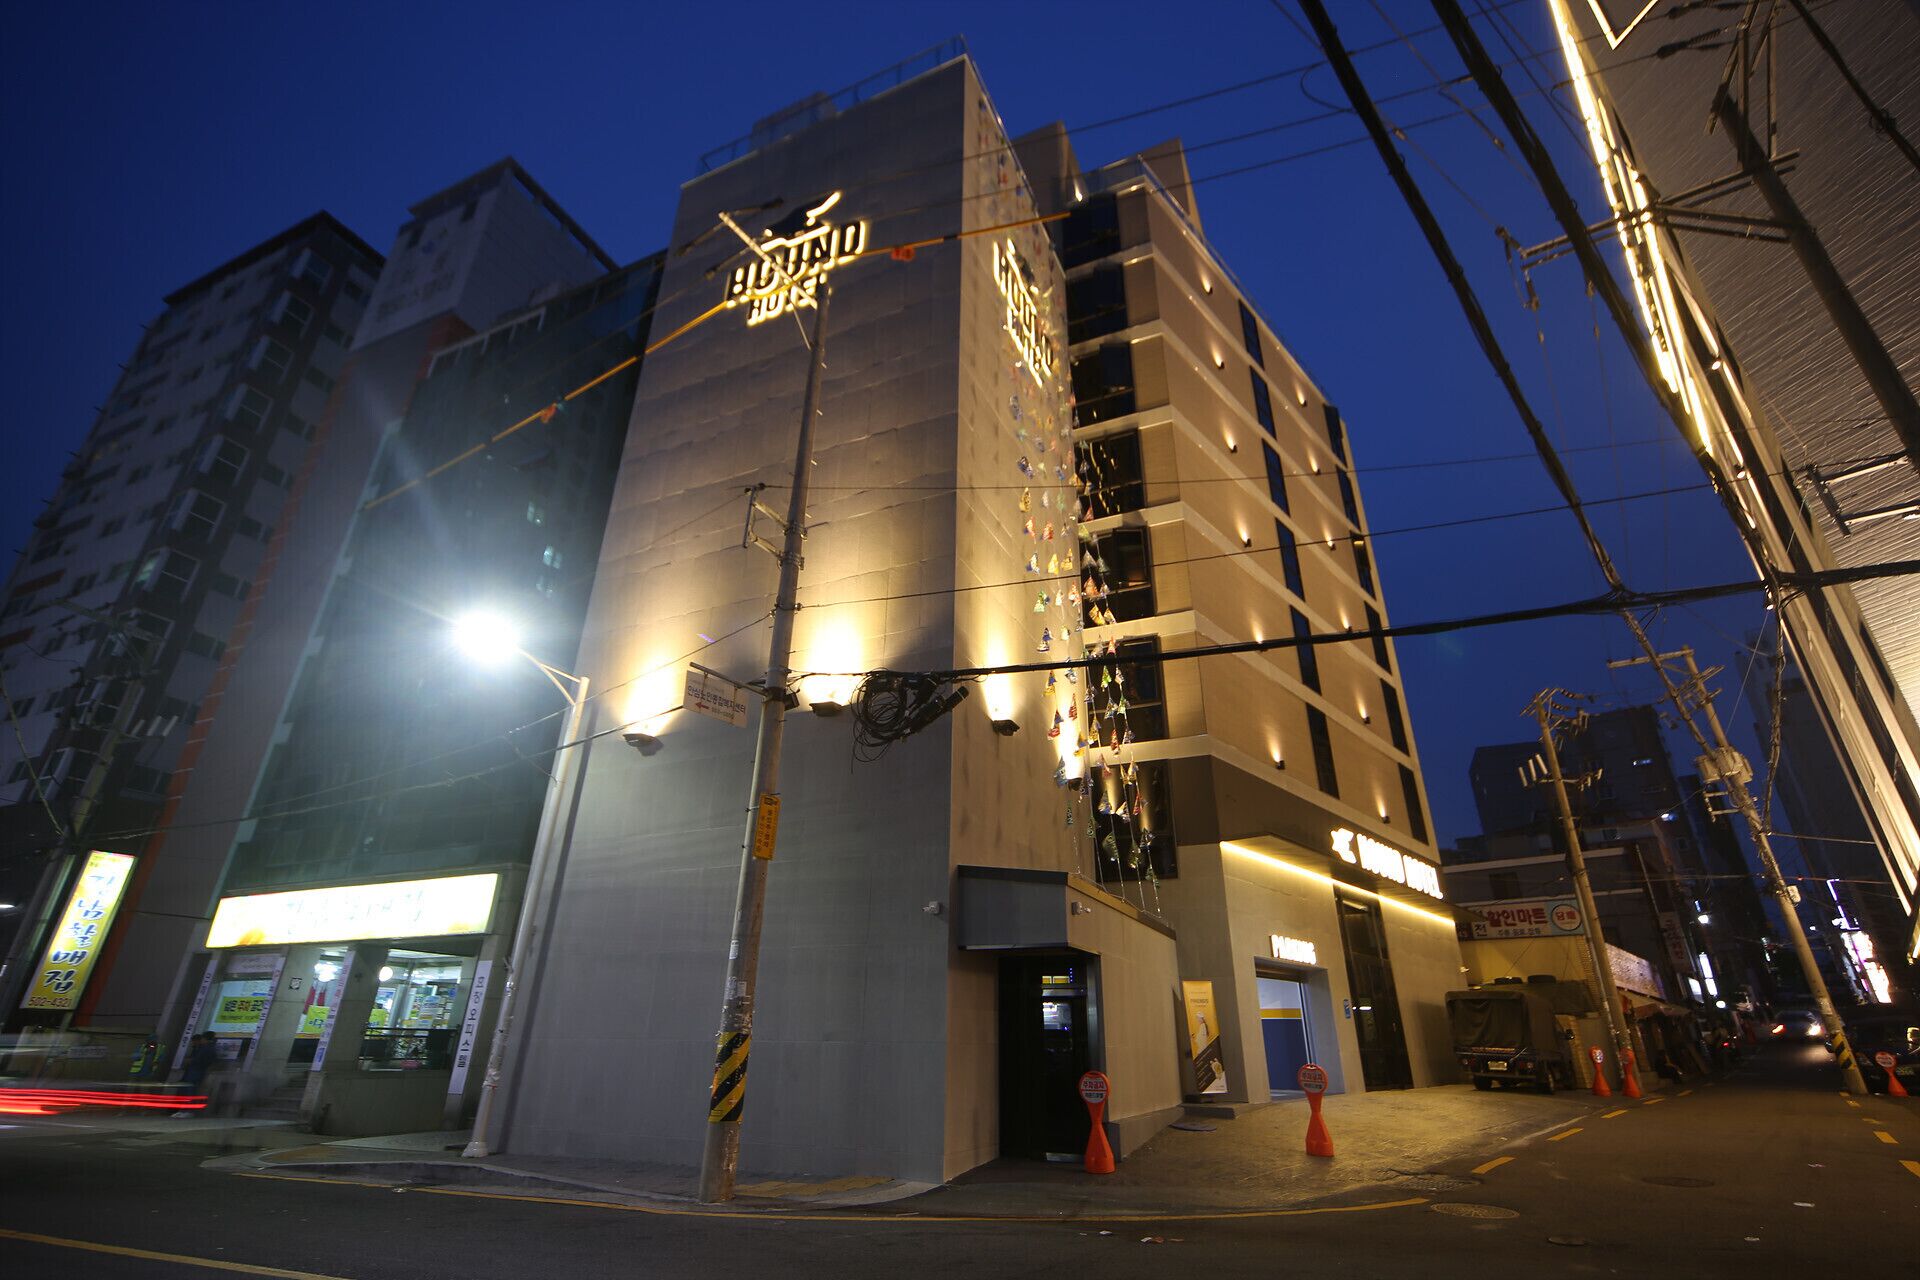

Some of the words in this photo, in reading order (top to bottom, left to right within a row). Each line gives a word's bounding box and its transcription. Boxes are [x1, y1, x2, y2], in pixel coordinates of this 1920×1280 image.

[1403, 854, 1444, 900] HOTEL
[1487, 908, 1548, 928] 할인마트
[1270, 934, 1317, 965] PARKING
